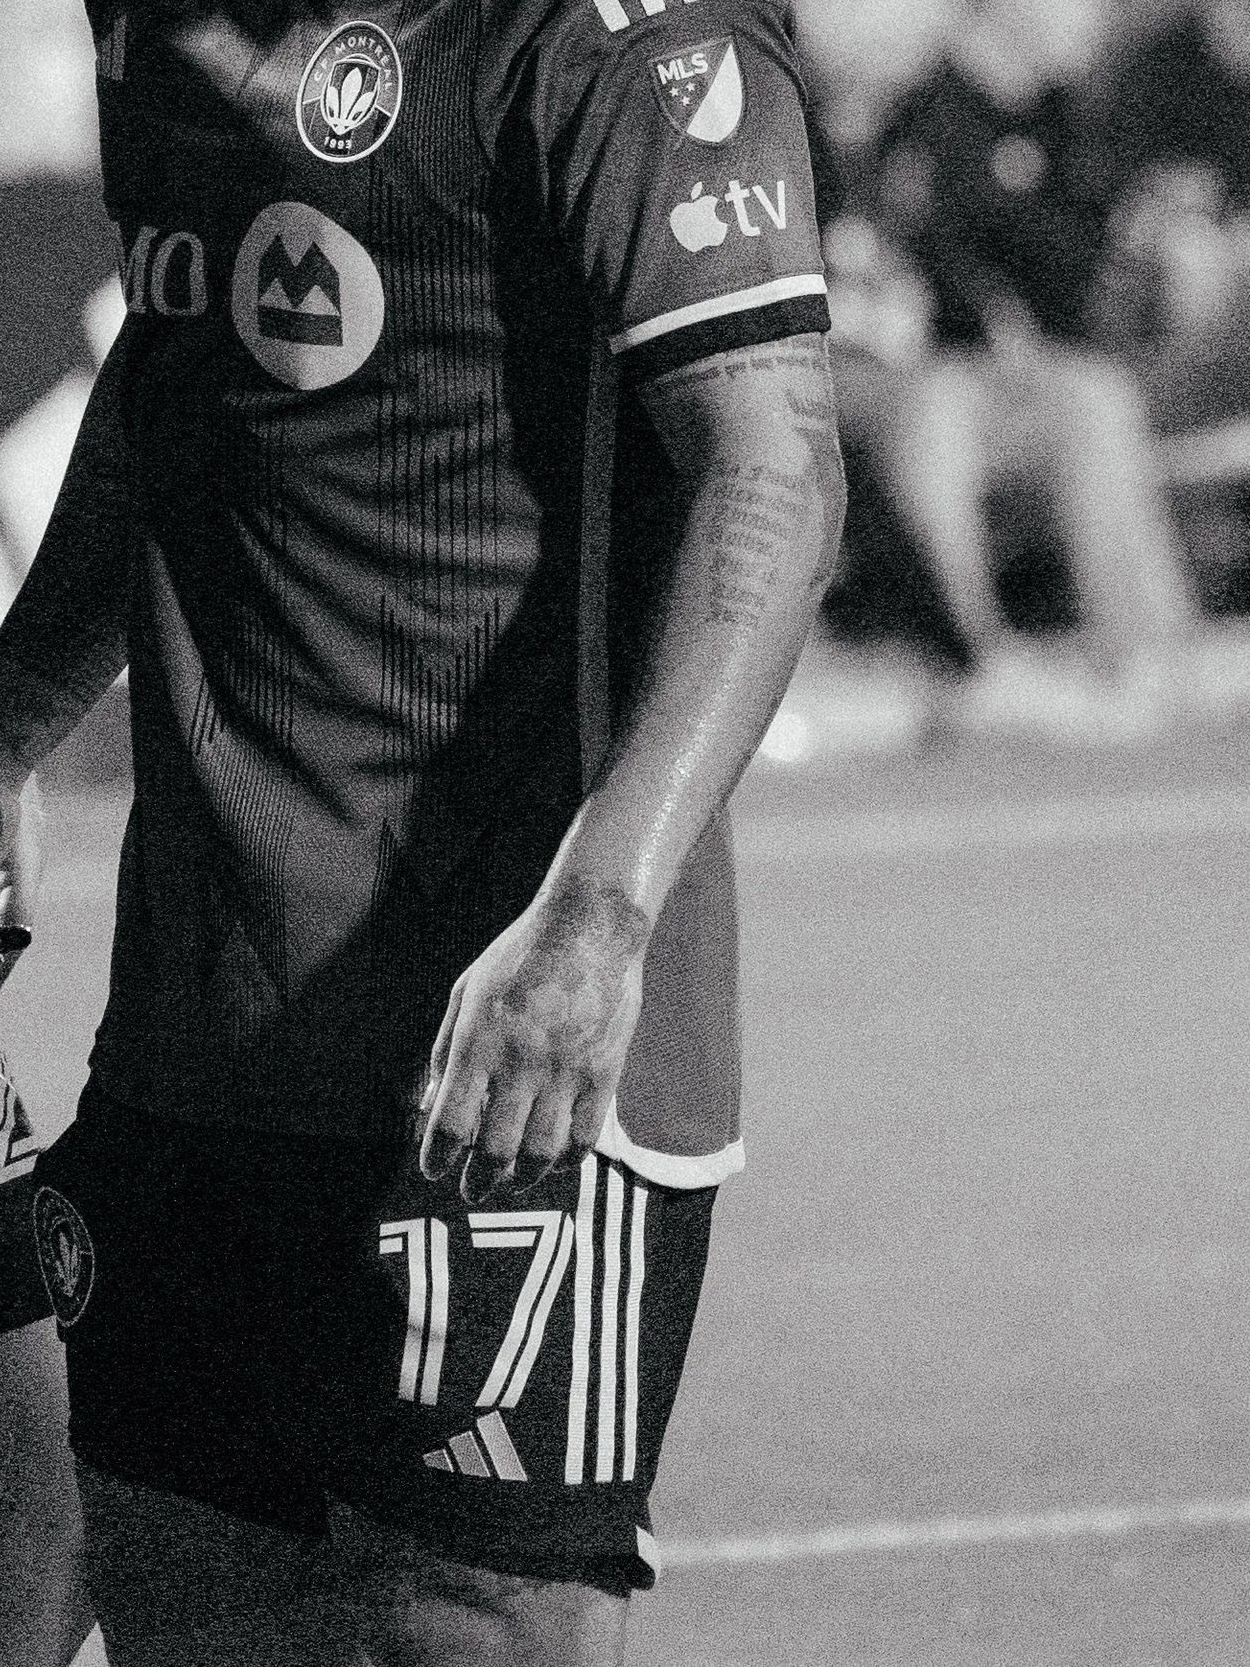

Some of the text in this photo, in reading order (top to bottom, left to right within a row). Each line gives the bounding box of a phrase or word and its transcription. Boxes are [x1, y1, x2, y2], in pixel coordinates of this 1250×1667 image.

[657, 53, 709, 84] MLS
[324, 136, 352, 150] 1993
[725, 180, 786, 237] tv
[379, 1210, 575, 1409] 17
